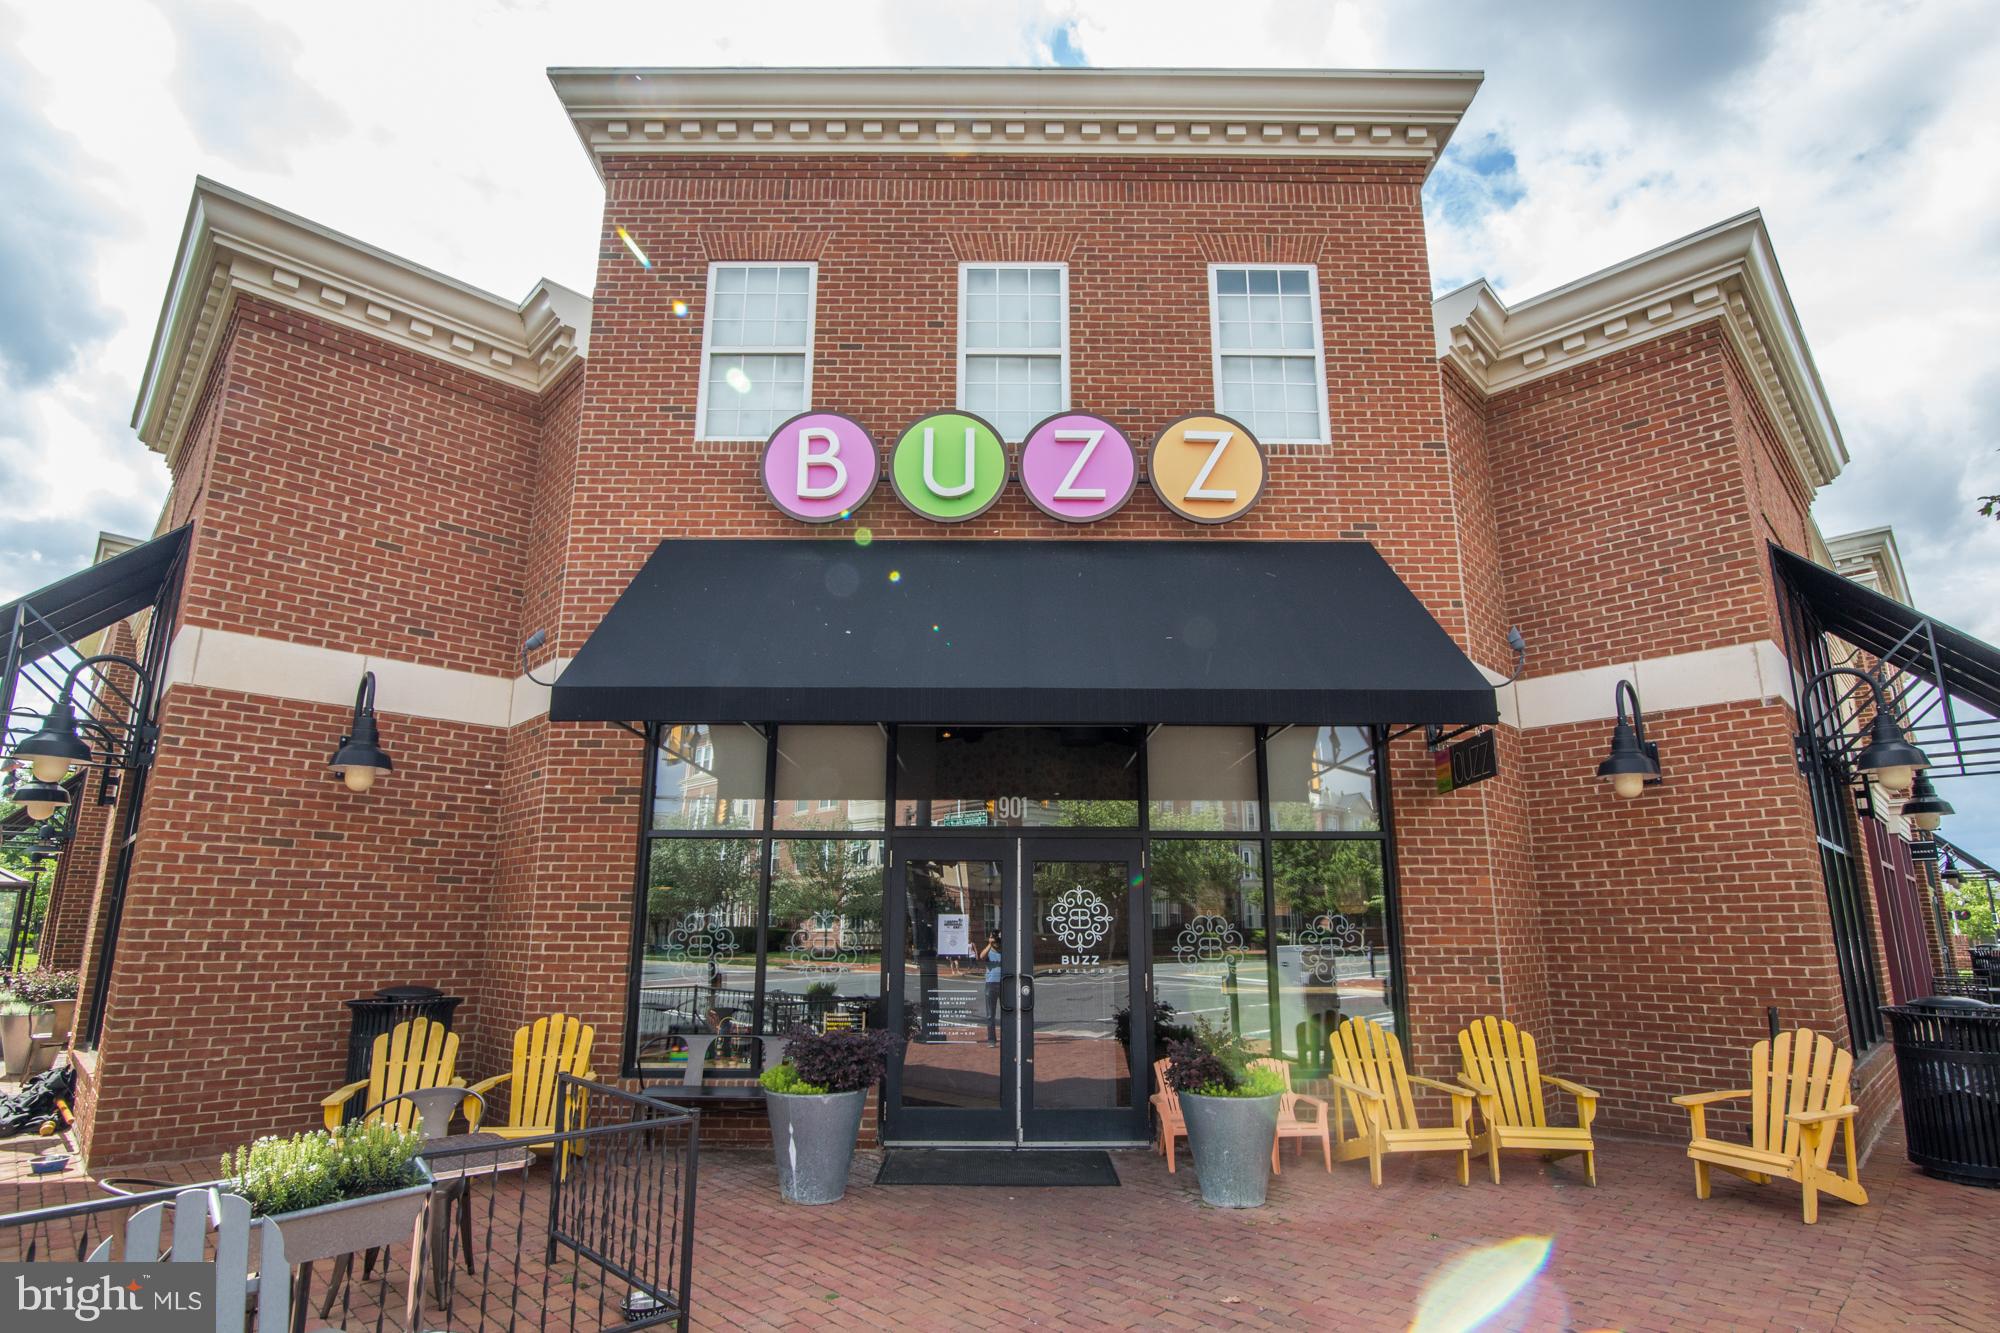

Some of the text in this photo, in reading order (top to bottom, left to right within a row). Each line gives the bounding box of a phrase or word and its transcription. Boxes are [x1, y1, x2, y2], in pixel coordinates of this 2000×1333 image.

[796, 426, 1238, 502] BUZZ
[999, 796, 1028, 819] 901
[1061, 955, 1100, 965] BUZZ
